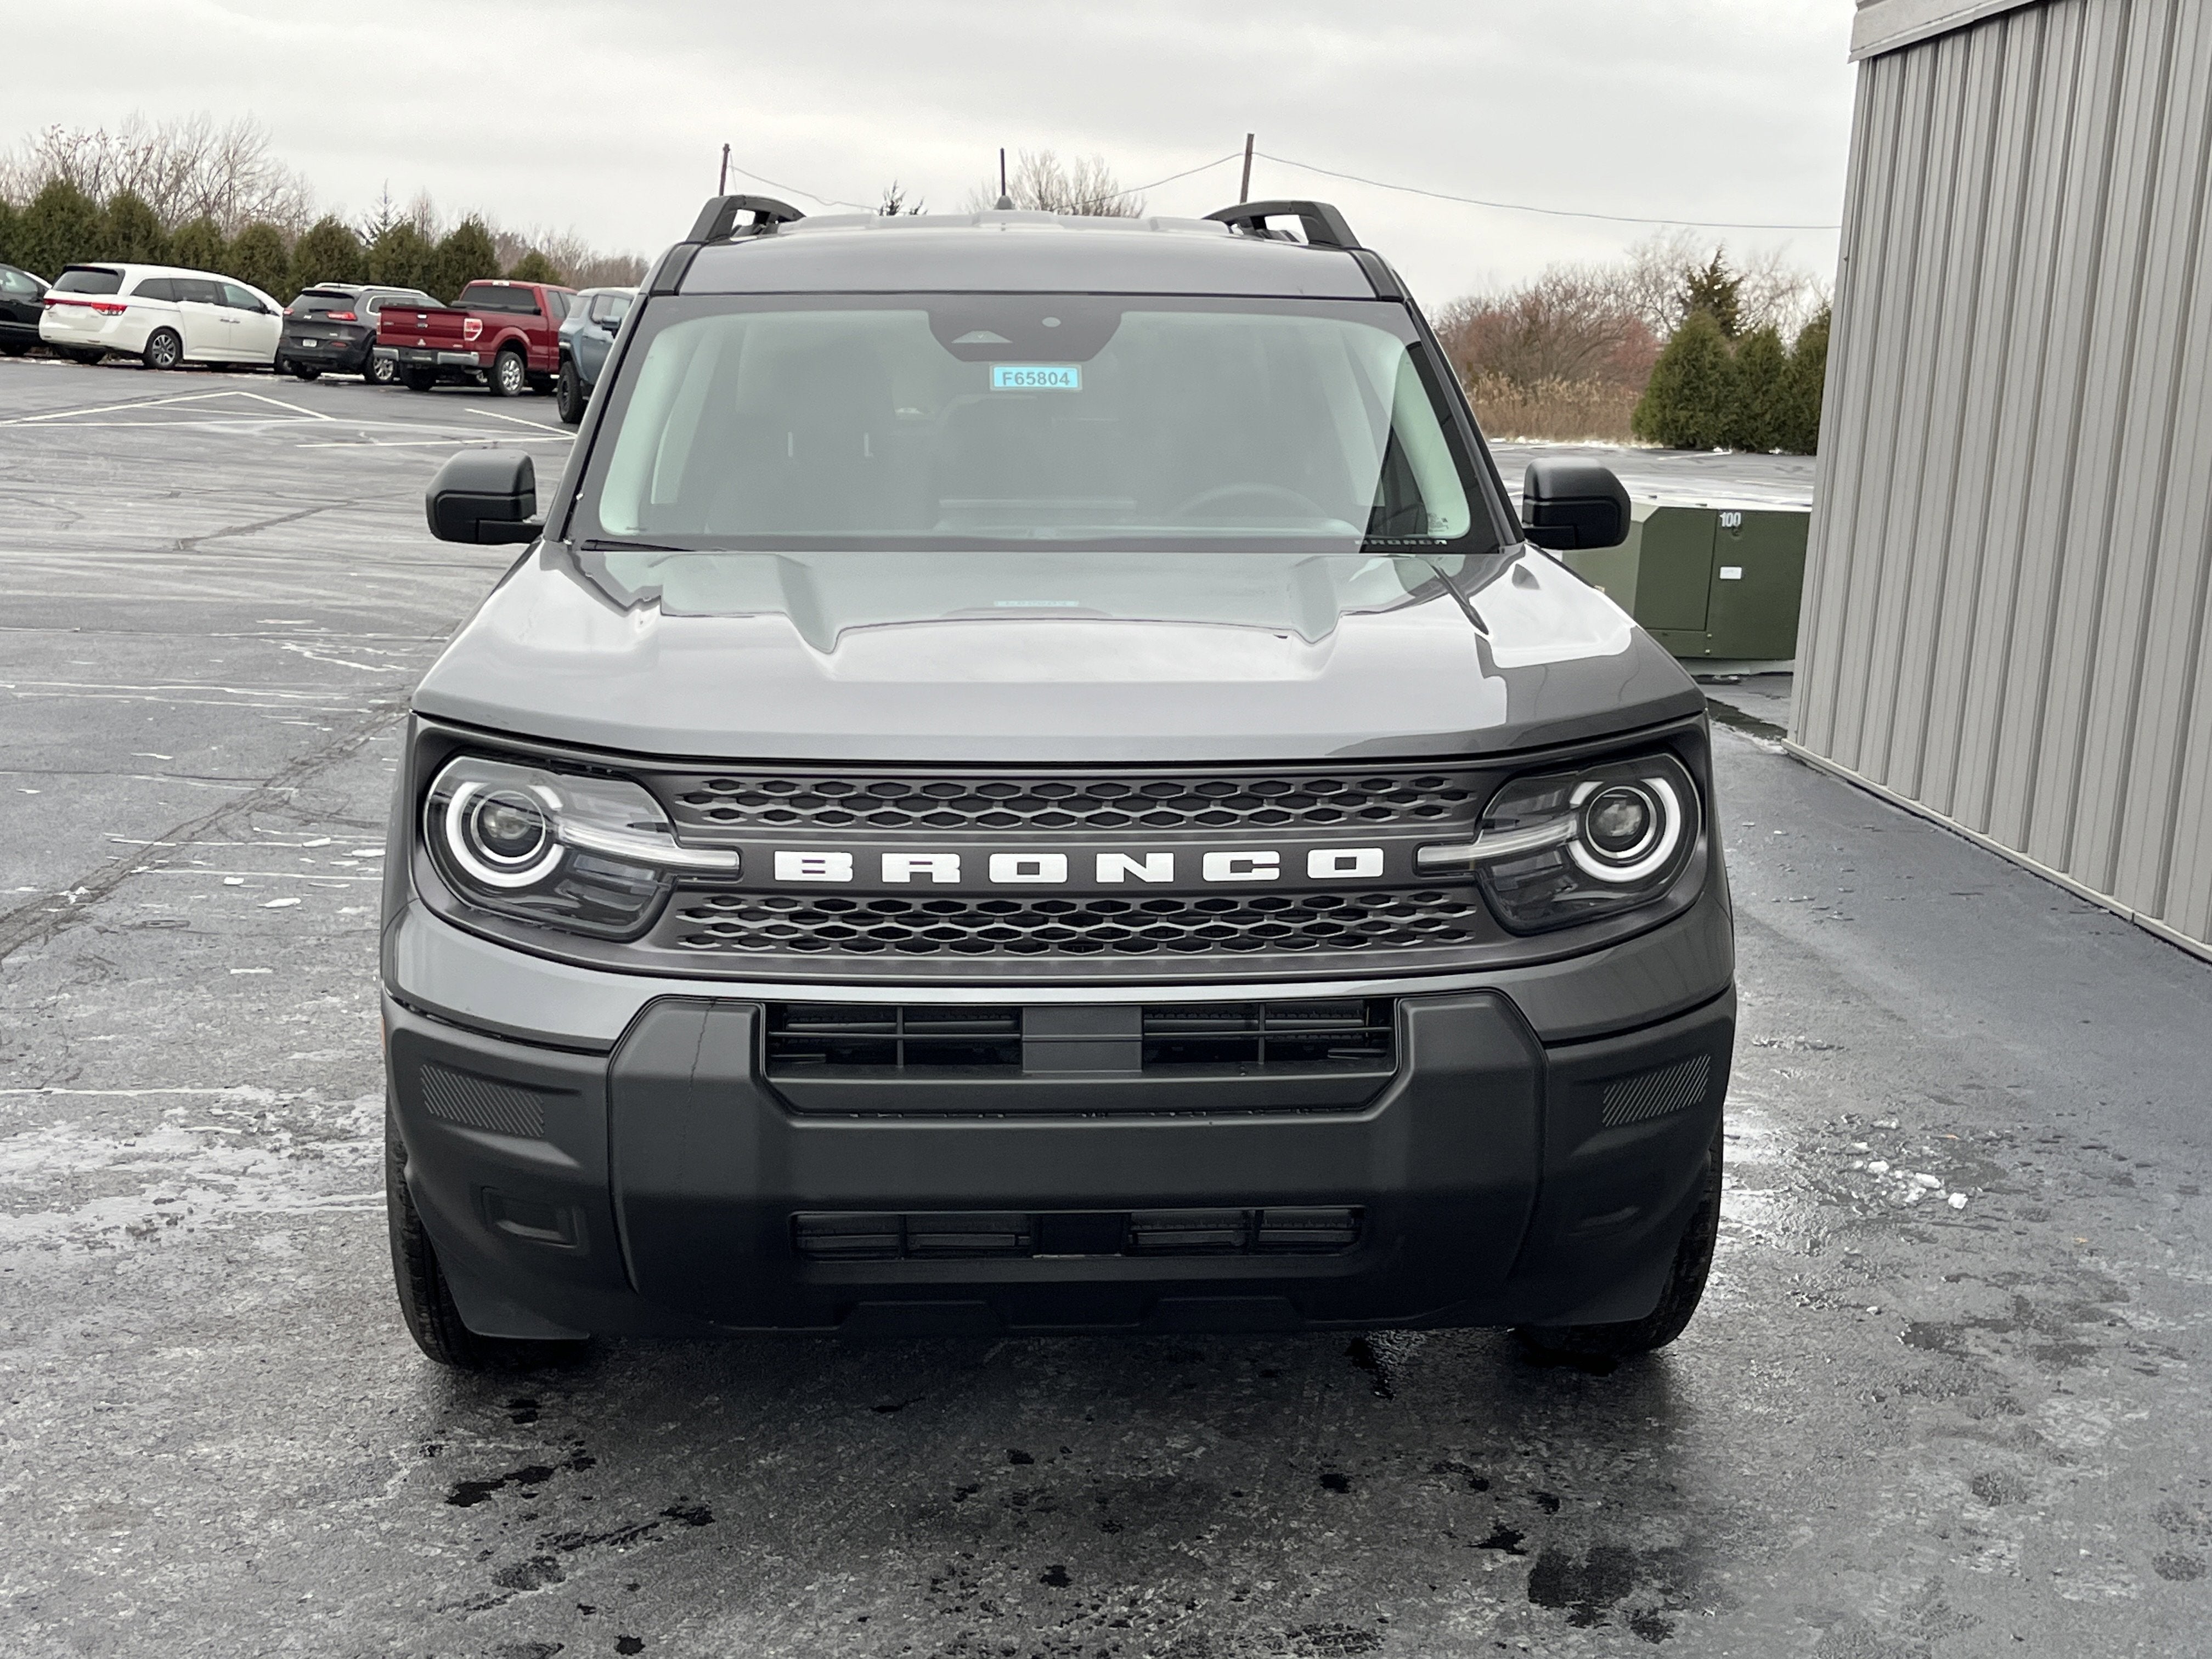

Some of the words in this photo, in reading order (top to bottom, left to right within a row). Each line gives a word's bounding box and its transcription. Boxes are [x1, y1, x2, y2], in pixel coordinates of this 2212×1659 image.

[1002, 371, 1070, 386] F65804
[1719, 511, 1741, 527] 100
[774, 848, 1384, 883] BRONCO
